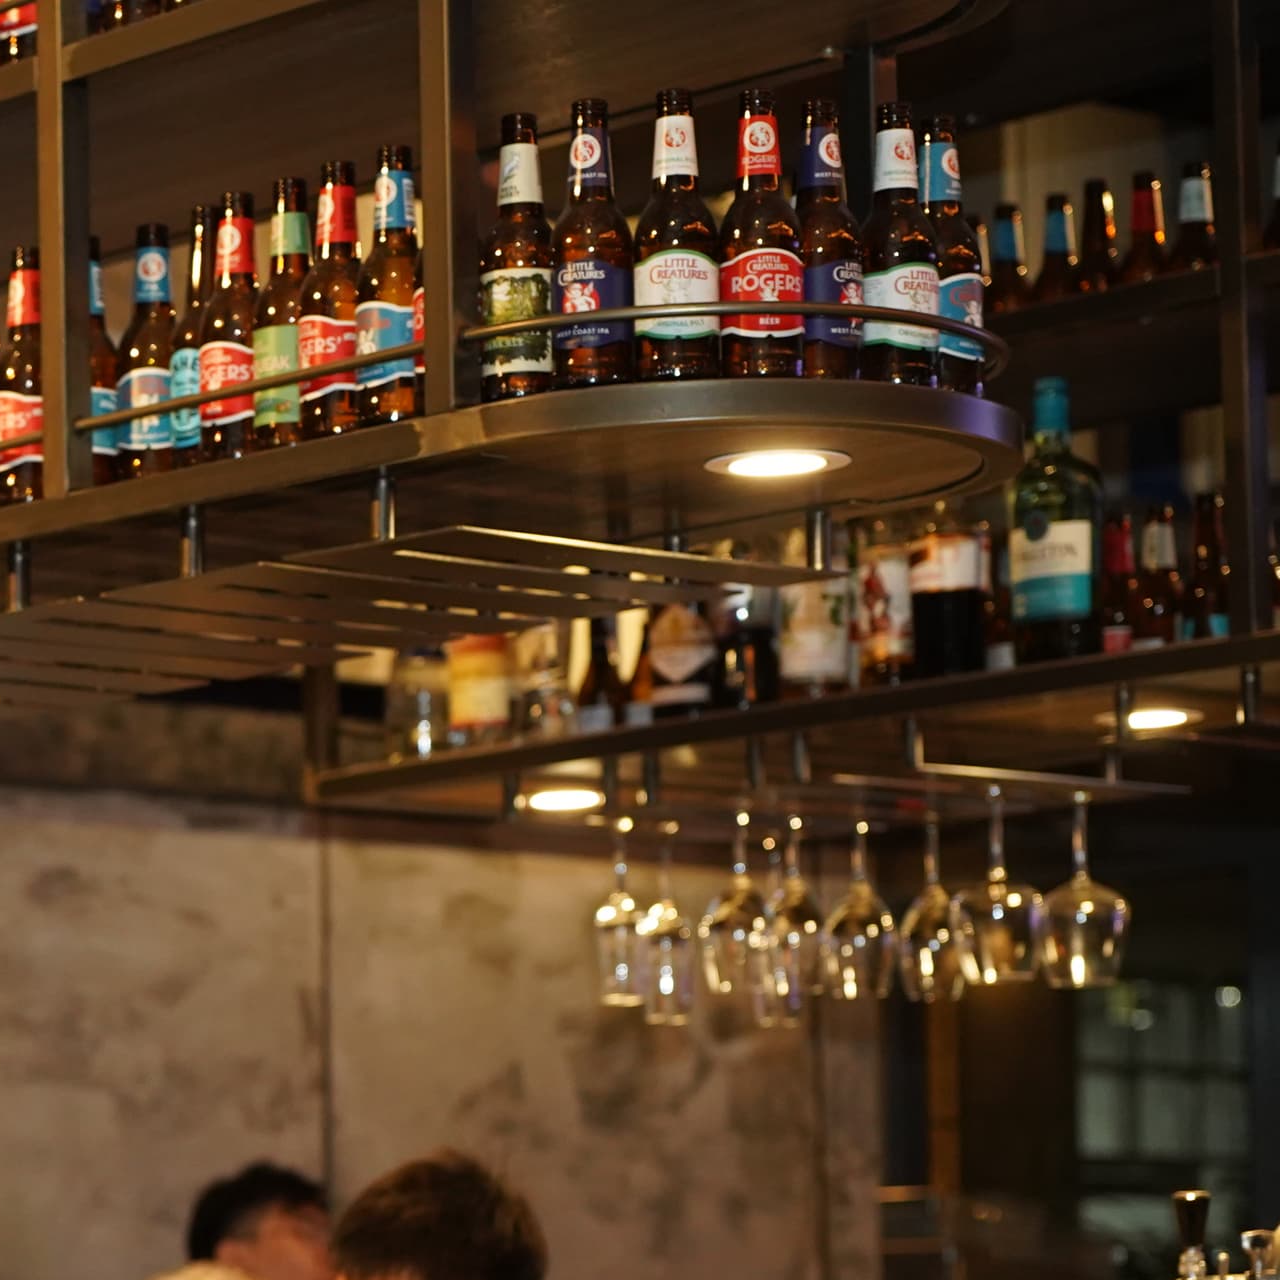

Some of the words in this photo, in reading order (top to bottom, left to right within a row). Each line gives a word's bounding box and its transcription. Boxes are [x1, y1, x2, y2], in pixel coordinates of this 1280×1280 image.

[665, 258, 699, 269] LITTLE
[757, 255, 781, 264] LITTLE
[567, 261, 597, 272] LITTLE
[746, 260, 789, 274] CREATURES
[558, 270, 606, 287] CREATURES
[650, 265, 709, 285] CREATURES
[731, 273, 802, 294] ROGERS
[758, 317, 781, 326] BEER
[572, 327, 595, 336] COAST
[597, 327, 610, 335] IPA
